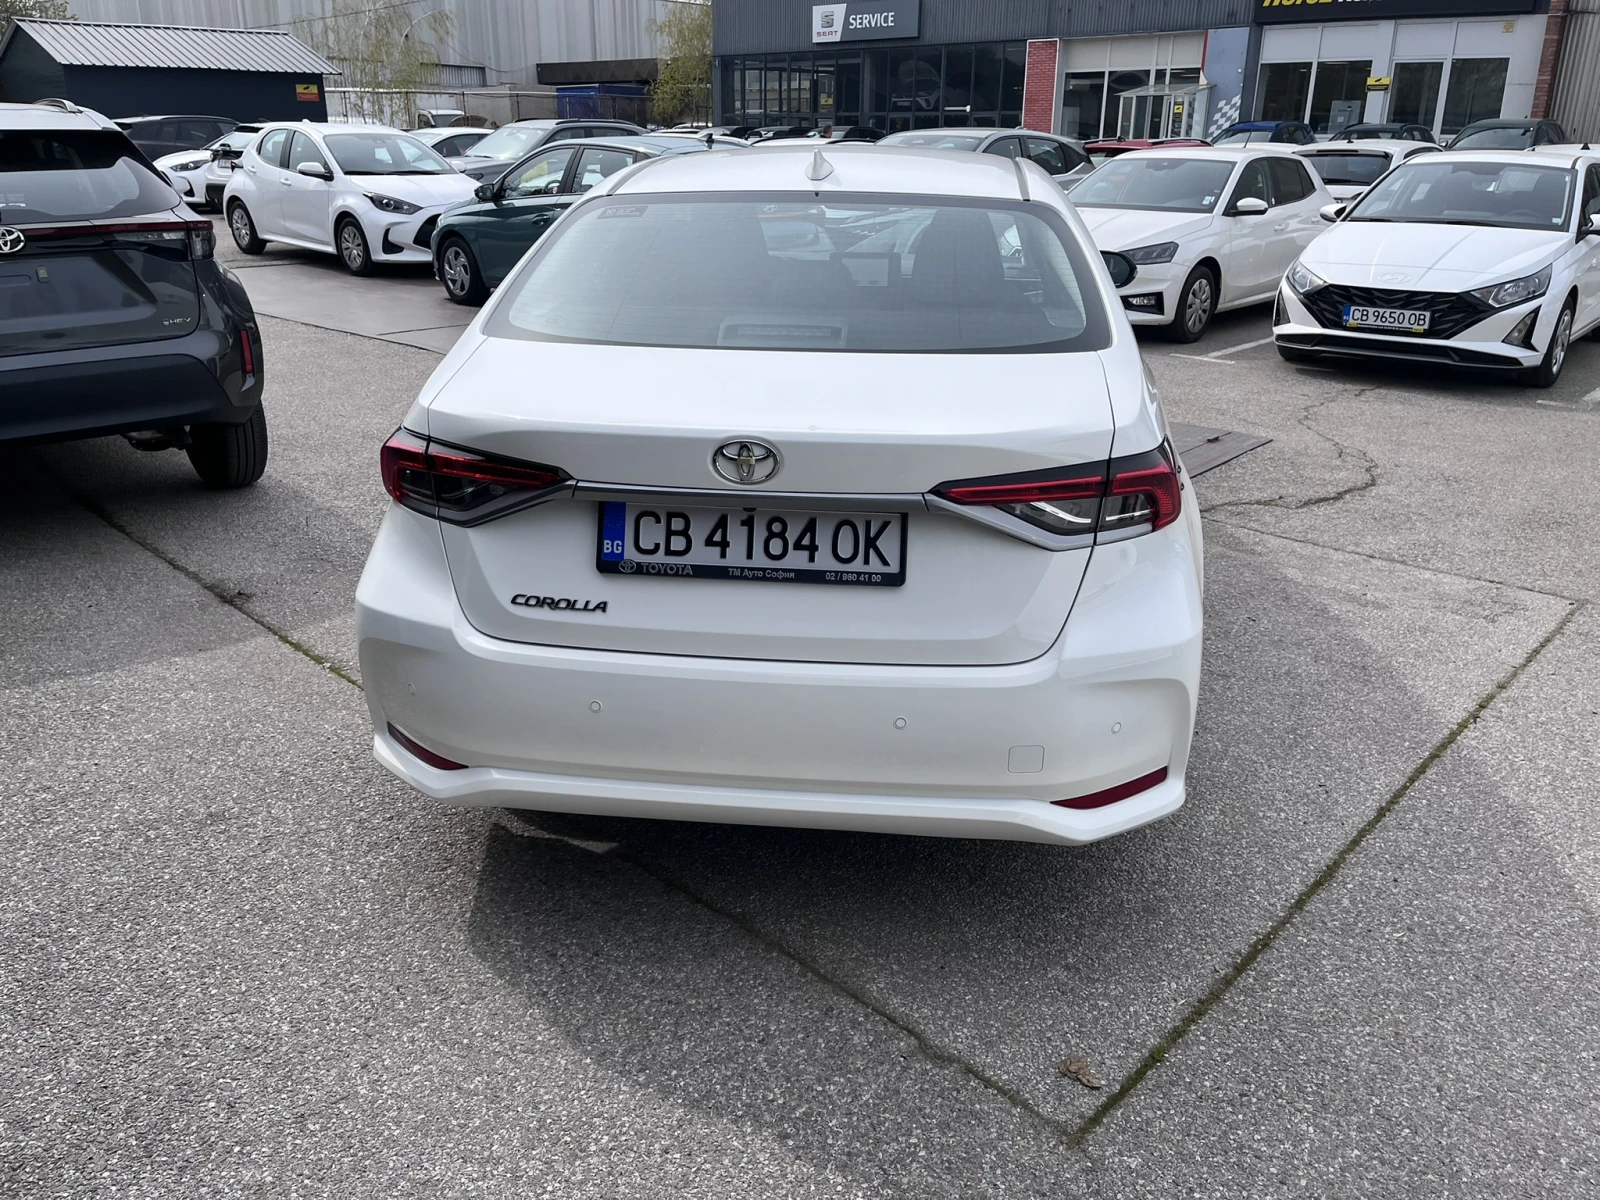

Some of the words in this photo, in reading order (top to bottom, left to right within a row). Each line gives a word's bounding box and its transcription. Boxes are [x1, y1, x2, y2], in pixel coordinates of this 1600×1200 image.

[849, 12, 895, 29] SERVICE
[1352, 308, 1370, 322] CB
[1372, 310, 1405, 324] 9650
[1408, 312, 1427, 326] OB
[633, 510, 693, 557] CB
[704, 513, 820, 563] 4184
[831, 519, 892, 567] OK
[603, 540, 623, 554] BG
[641, 563, 693, 575] TOYOTA
[742, 569, 763, 578] Ауто
[765, 570, 795, 579] София
[825, 572, 836, 580] 02
[859, 574, 869, 582] 41
[871, 574, 881, 582] 00
[510, 593, 609, 613] COROLLA
